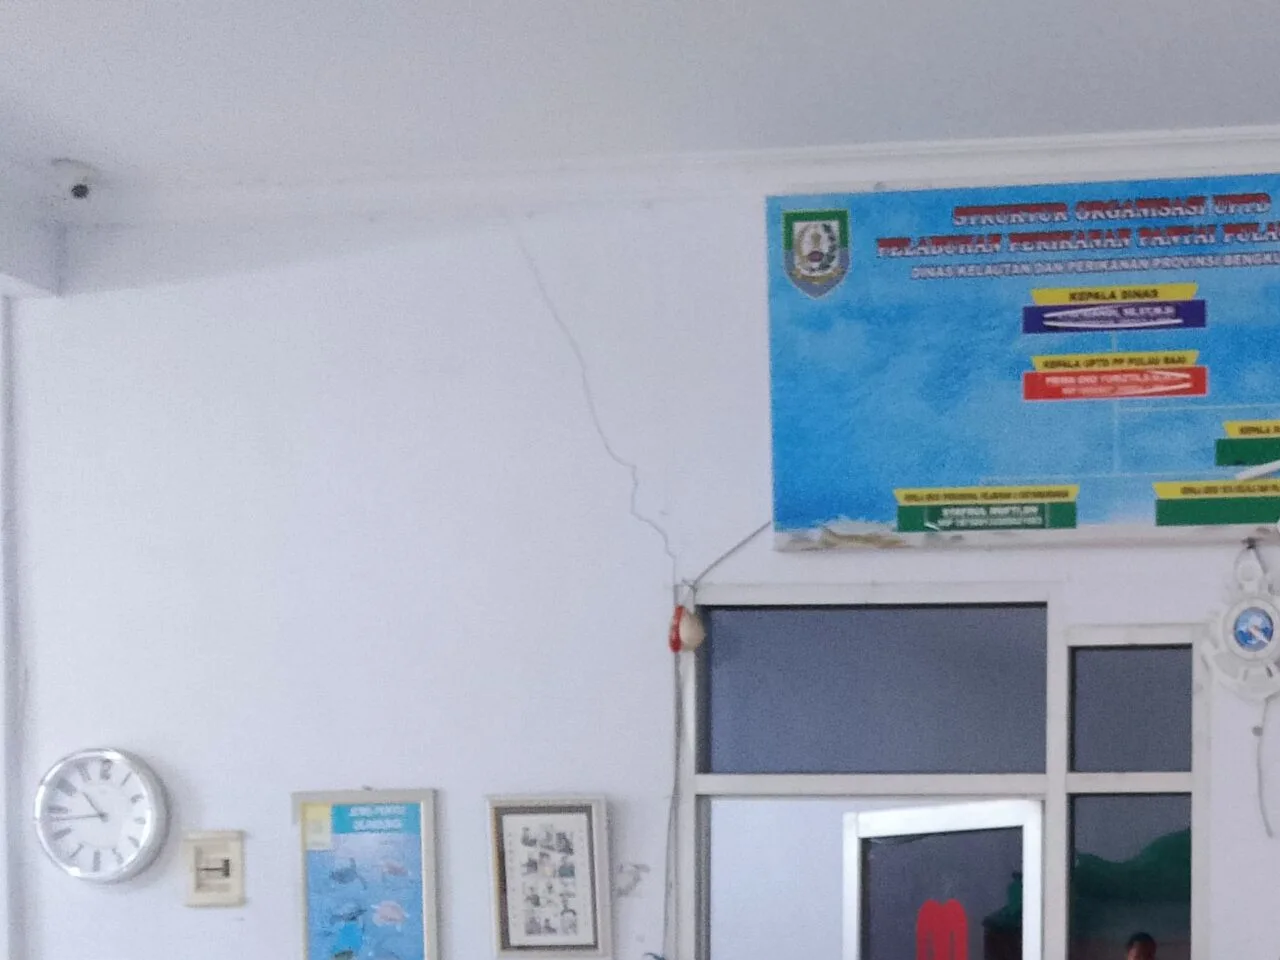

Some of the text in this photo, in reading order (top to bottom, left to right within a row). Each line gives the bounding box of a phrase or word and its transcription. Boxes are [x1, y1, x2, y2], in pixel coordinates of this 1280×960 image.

[957, 261, 1031, 278] KELAUTAN
[1034, 258, 1064, 275] DAN
[1067, 254, 1149, 273] PERIKANAN
